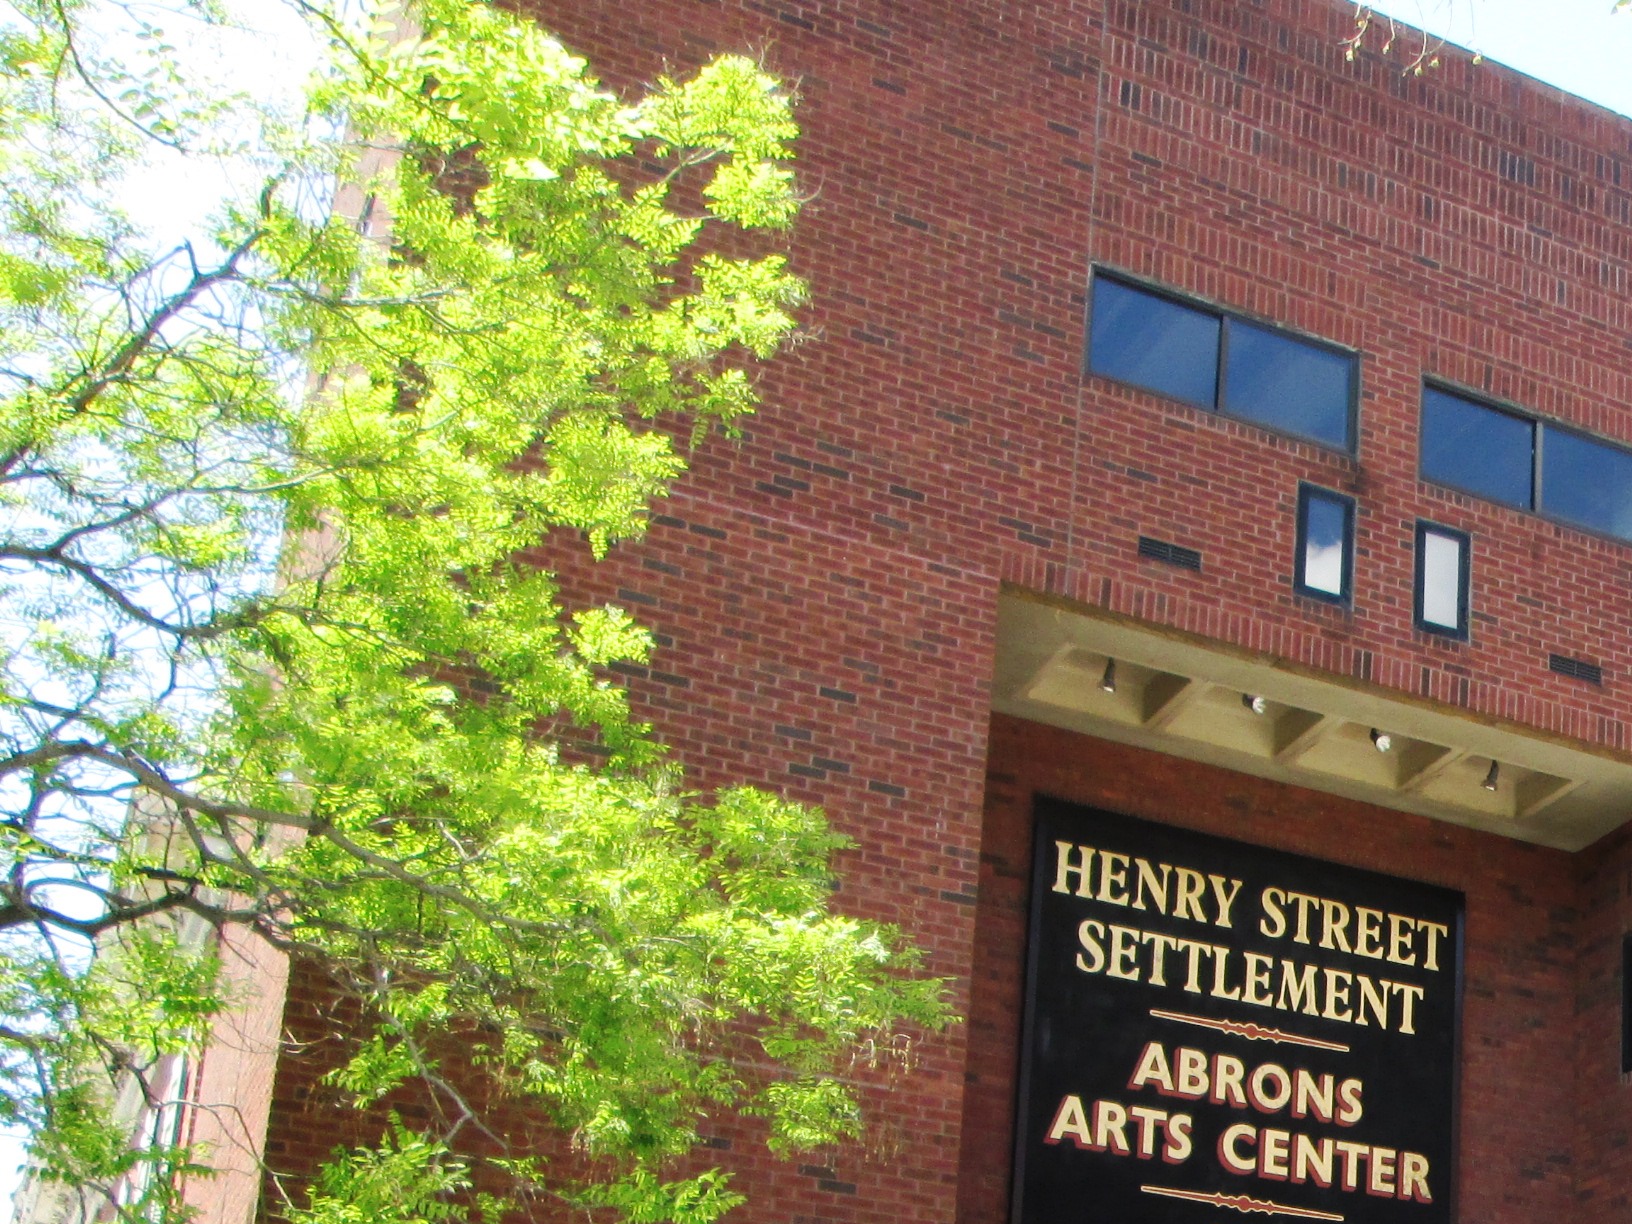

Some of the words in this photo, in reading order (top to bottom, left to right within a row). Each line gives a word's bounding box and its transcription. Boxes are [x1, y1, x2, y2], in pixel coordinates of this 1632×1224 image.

[1052, 840, 1242, 928] HENRY
[1259, 887, 1447, 972] STREET
[1076, 919, 1423, 1035] SETTLEMENT
[1127, 1042, 1363, 1124] ABRONS
[1044, 1095, 1192, 1163] ARTS
[1218, 1123, 1433, 1204] CENTER
